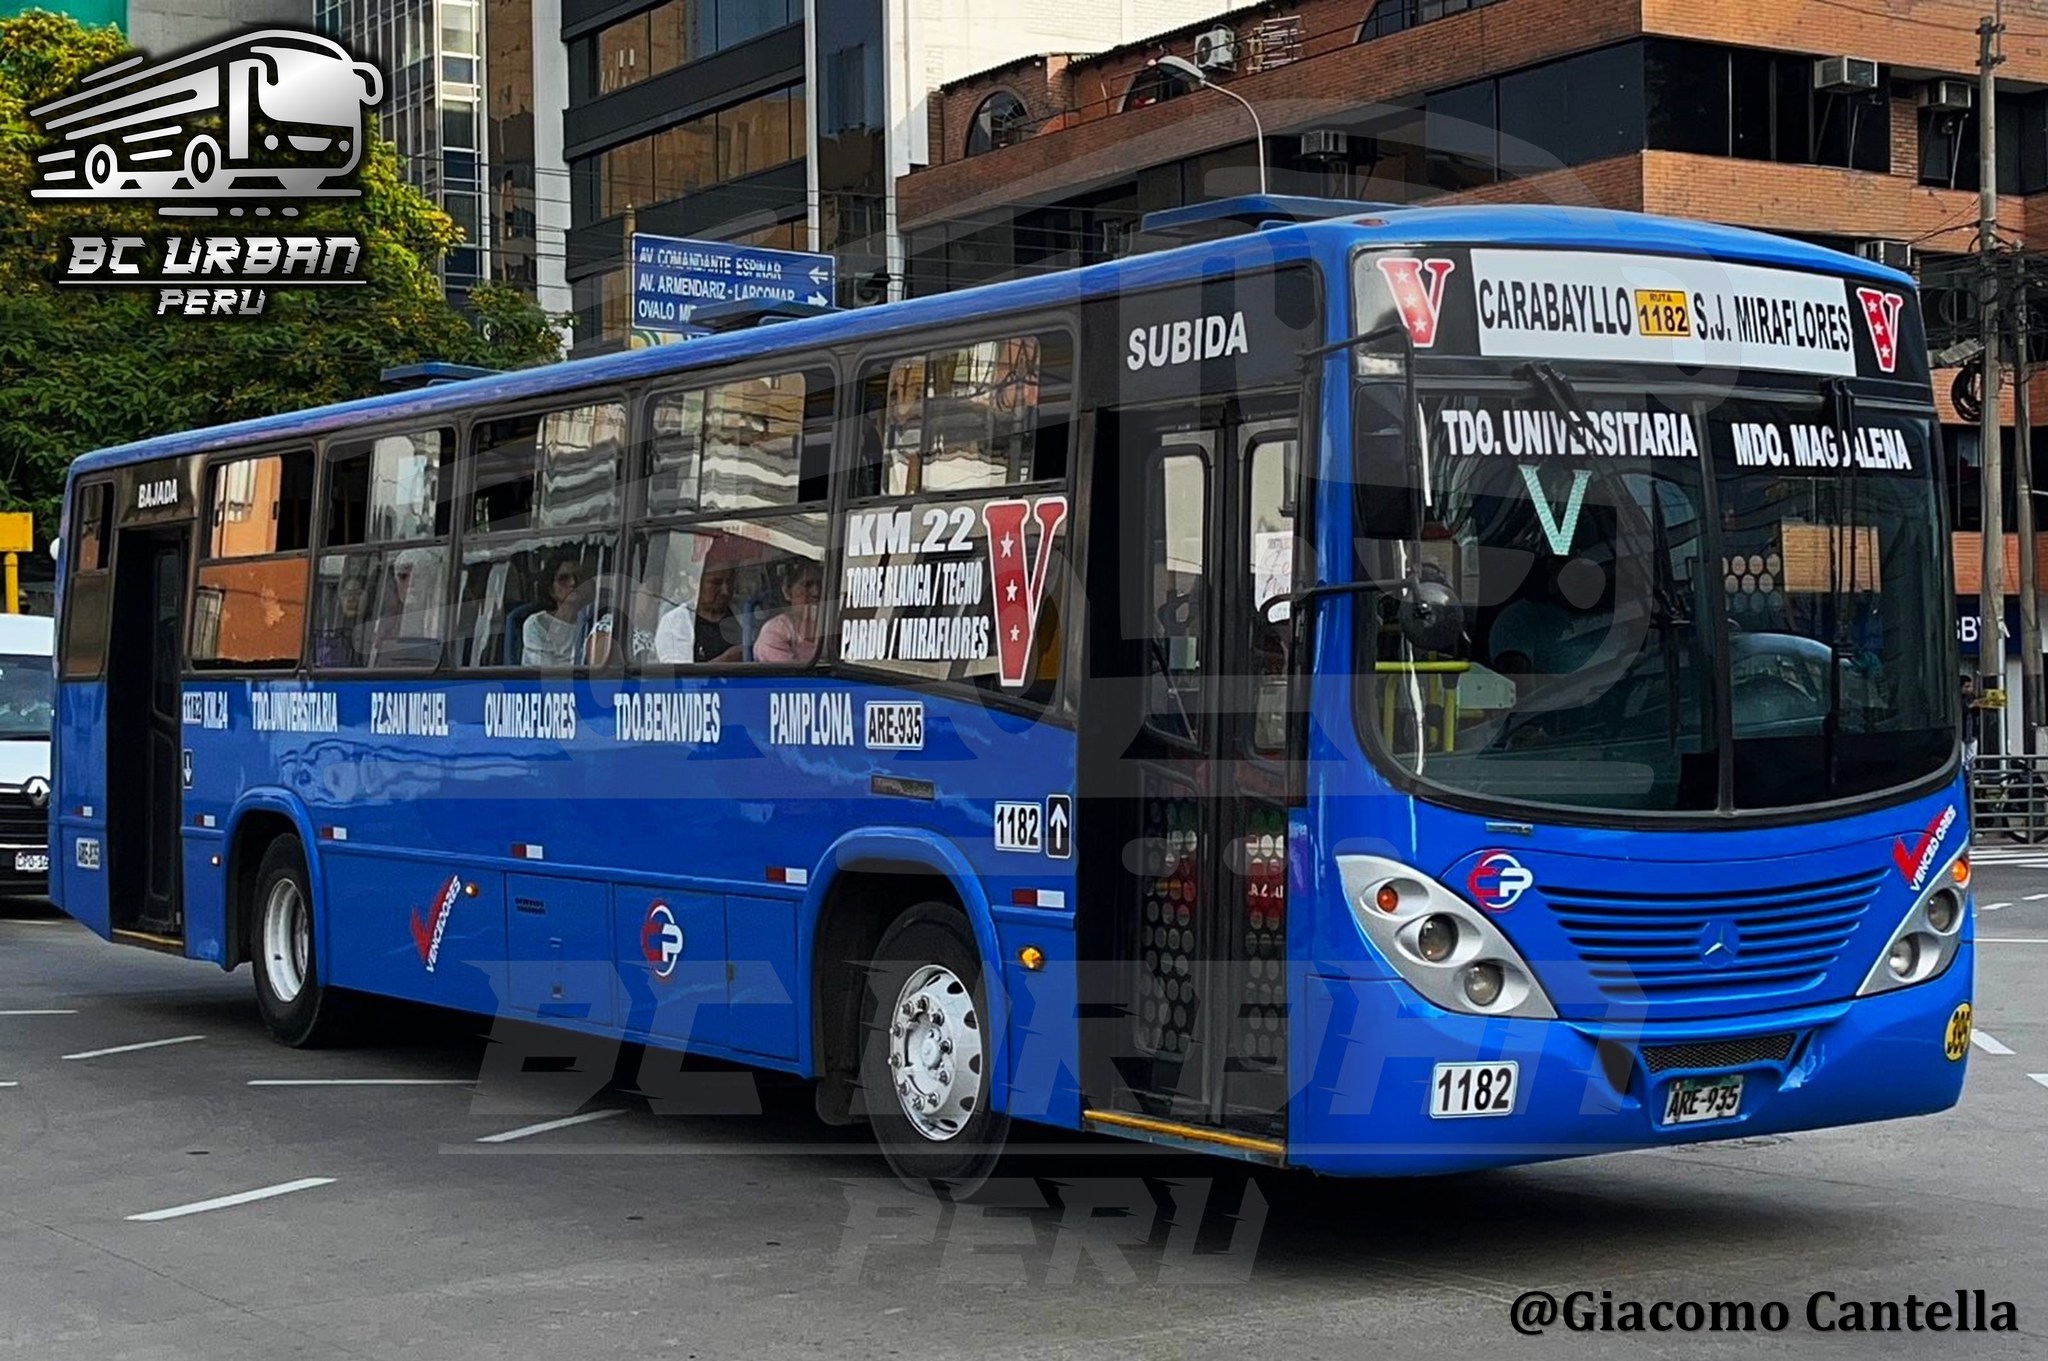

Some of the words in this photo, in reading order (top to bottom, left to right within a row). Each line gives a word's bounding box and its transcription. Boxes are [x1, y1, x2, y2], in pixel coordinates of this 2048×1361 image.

[638, 300, 675, 320] OVALO
[658, 278, 726, 299] ARMENDARIZ
[1479, 279, 1632, 336] CARABAYLLO
[1649, 294, 1672, 302] RUTA
[1127, 310, 1249, 371] SUBIDA
[1639, 305, 1689, 332] 1182
[1693, 292, 1732, 342] S.J.
[1733, 296, 1850, 352] MIRAFLORES
[1441, 409, 1501, 456] TDO.
[1503, 410, 1699, 457] UNIVERSITARIA
[1731, 423, 1790, 466] MDO.
[138, 478, 178, 509] BAJADA
[848, 507, 976, 556] KM.22
[846, 565, 883, 608] TORRE
[884, 563, 931, 606] BLANCA
[840, 618, 888, 660] PARDO
[898, 616, 990, 660] MIRAFLORES
[408, 693, 448, 736] MIGUEL
[770, 692, 854, 746] PAMPLONA
[868, 706, 922, 744] ARE-935
[997, 806, 1039, 846] 1182
[1910, 804, 1957, 891] VENCEDORES
[426, 874, 462, 972] VENCEDORES
[1437, 1067, 1513, 1112] 1182
[1667, 1084, 1740, 1118] ARE-935
